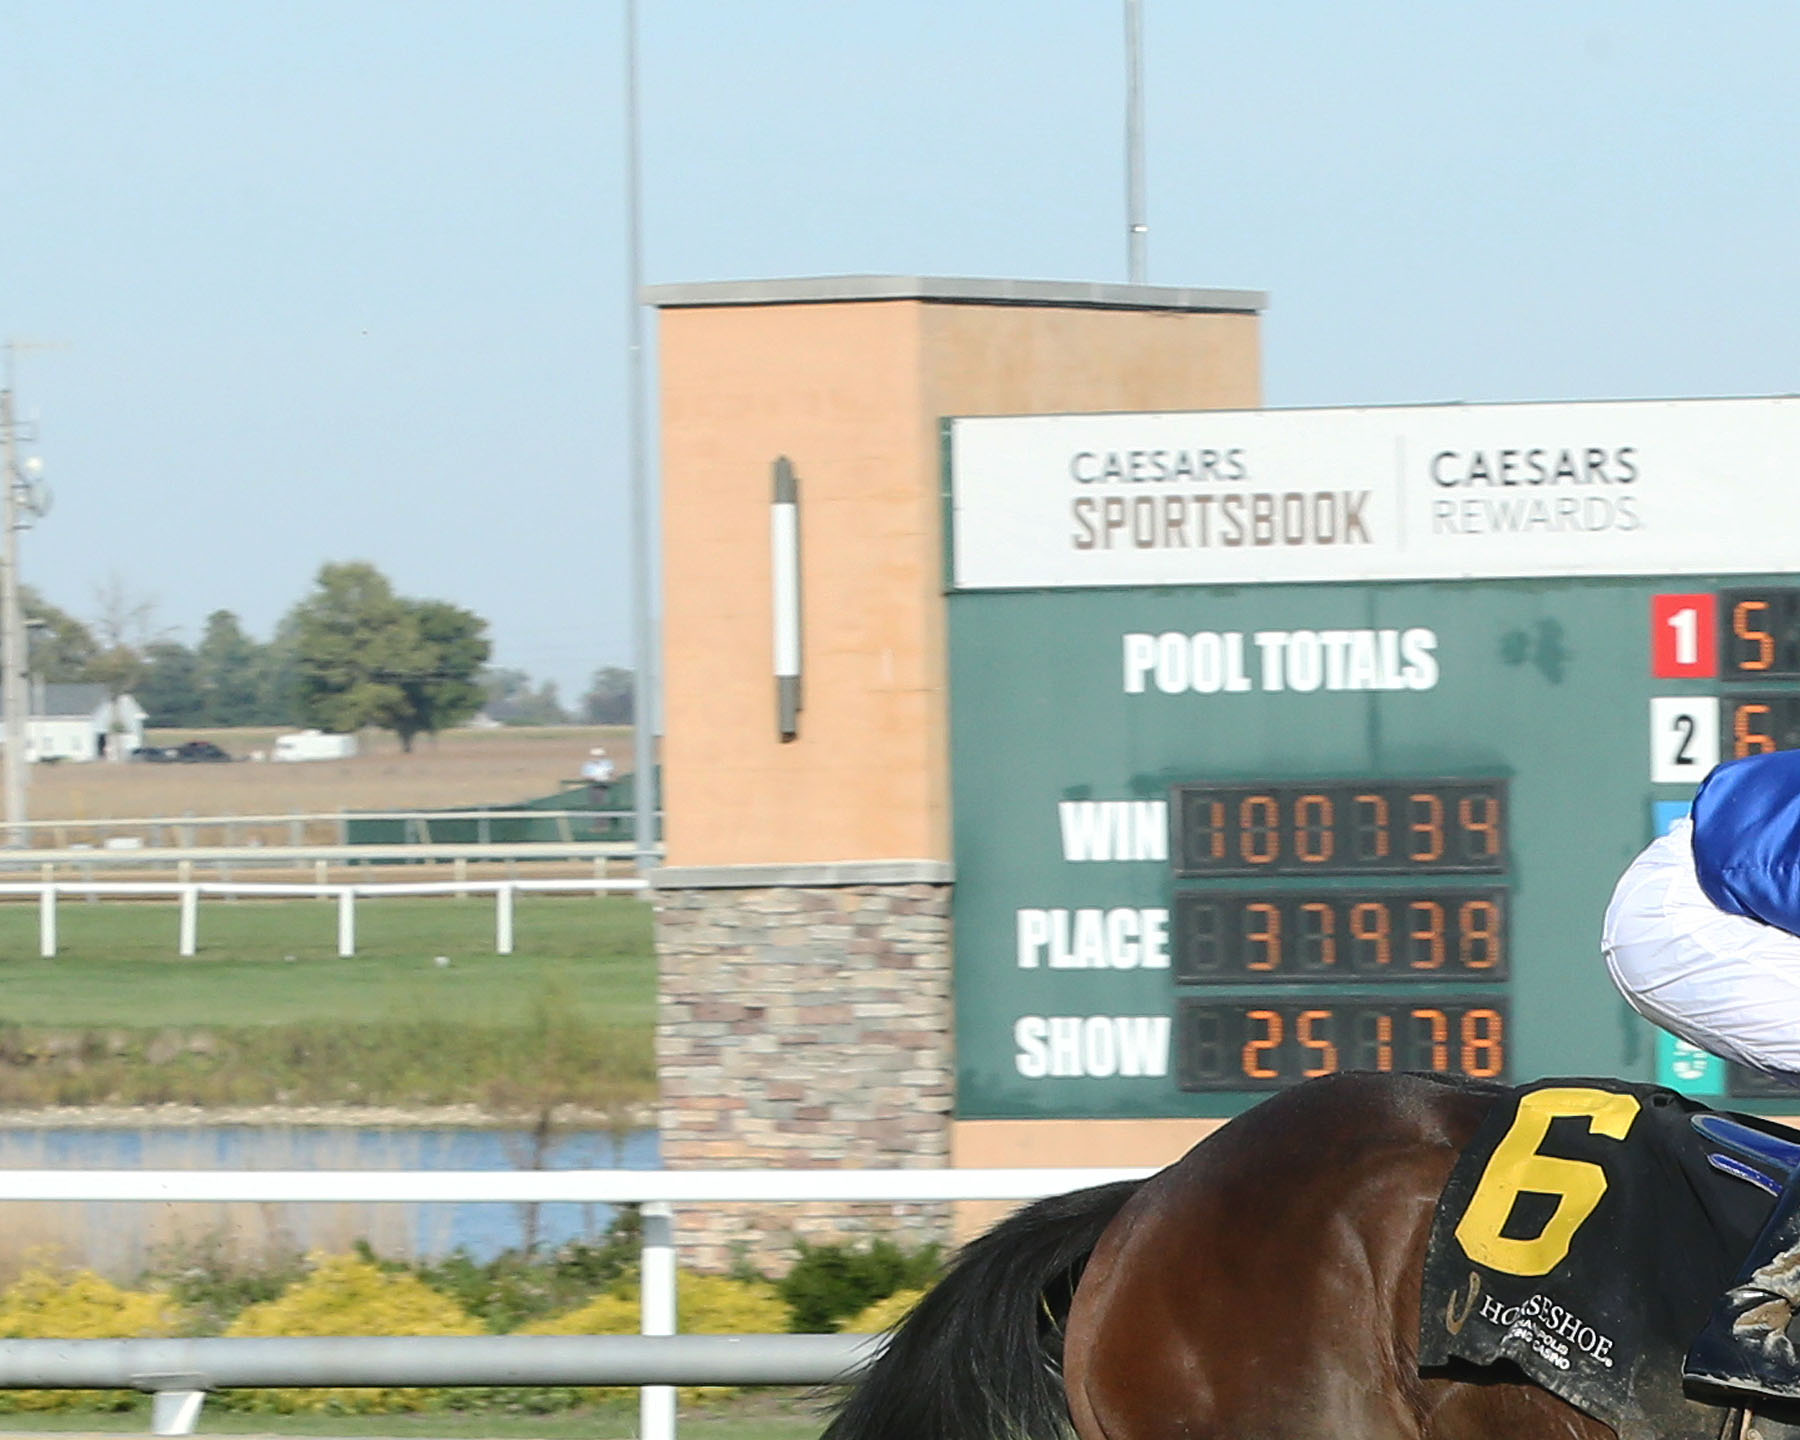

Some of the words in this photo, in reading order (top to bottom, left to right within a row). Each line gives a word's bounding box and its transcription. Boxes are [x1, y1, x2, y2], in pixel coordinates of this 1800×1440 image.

[1070, 447, 1248, 485] CAESARS
[1431, 446, 1639, 488] CAESARS
[1072, 490, 1374, 551] SPORTSBOOK
[1432, 496, 1641, 535] REWARDS
[1122, 632, 1252, 694] POOL
[1253, 627, 1439, 692] TOTALS
[1667, 607, 1698, 665] 1
[1673, 714, 1696, 766] 2
[1058, 800, 1169, 862] WIN
[1210, 794, 1499, 863] 100734
[1017, 907, 1171, 969] PLACE
[1246, 900, 1499, 972] 37938
[1015, 1014, 1172, 1078] SHOW
[1242, 1009, 1502, 1079] 25178
[1453, 1086, 1641, 1277] 6
